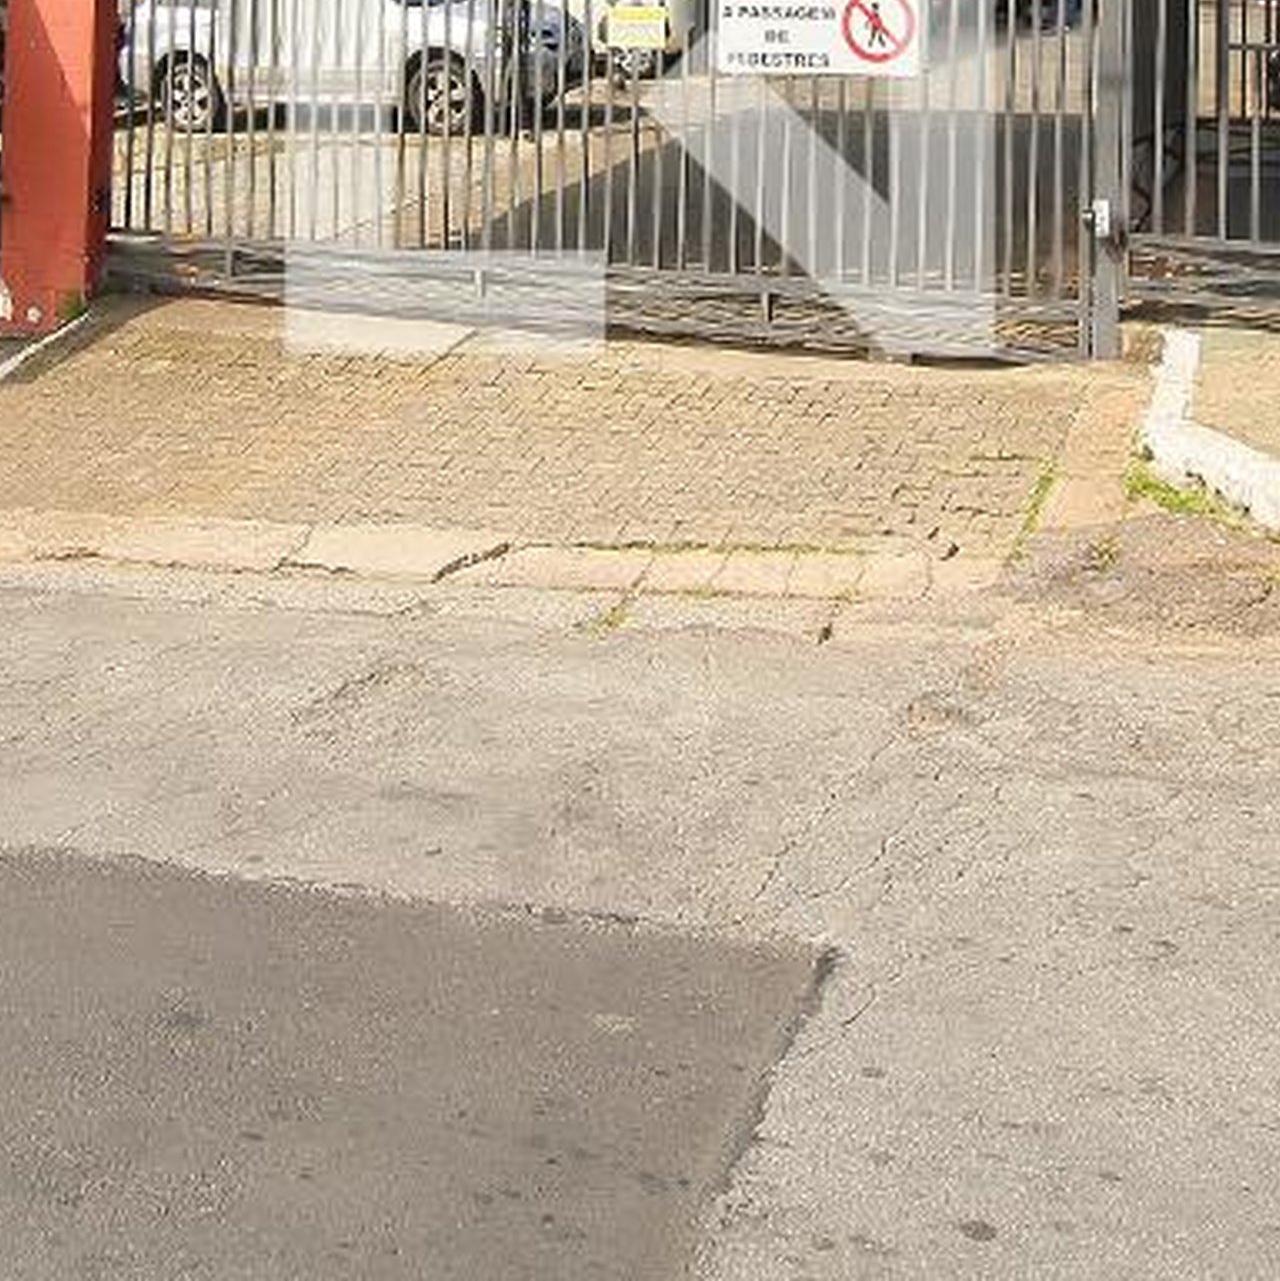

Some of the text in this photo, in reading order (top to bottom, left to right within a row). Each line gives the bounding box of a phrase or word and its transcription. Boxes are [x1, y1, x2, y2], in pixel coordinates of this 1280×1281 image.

[723, 5, 836, 21] A PASSAGEM
[764, 29, 791, 44] DE
[727, 52, 830, 68] PEDESTRES
